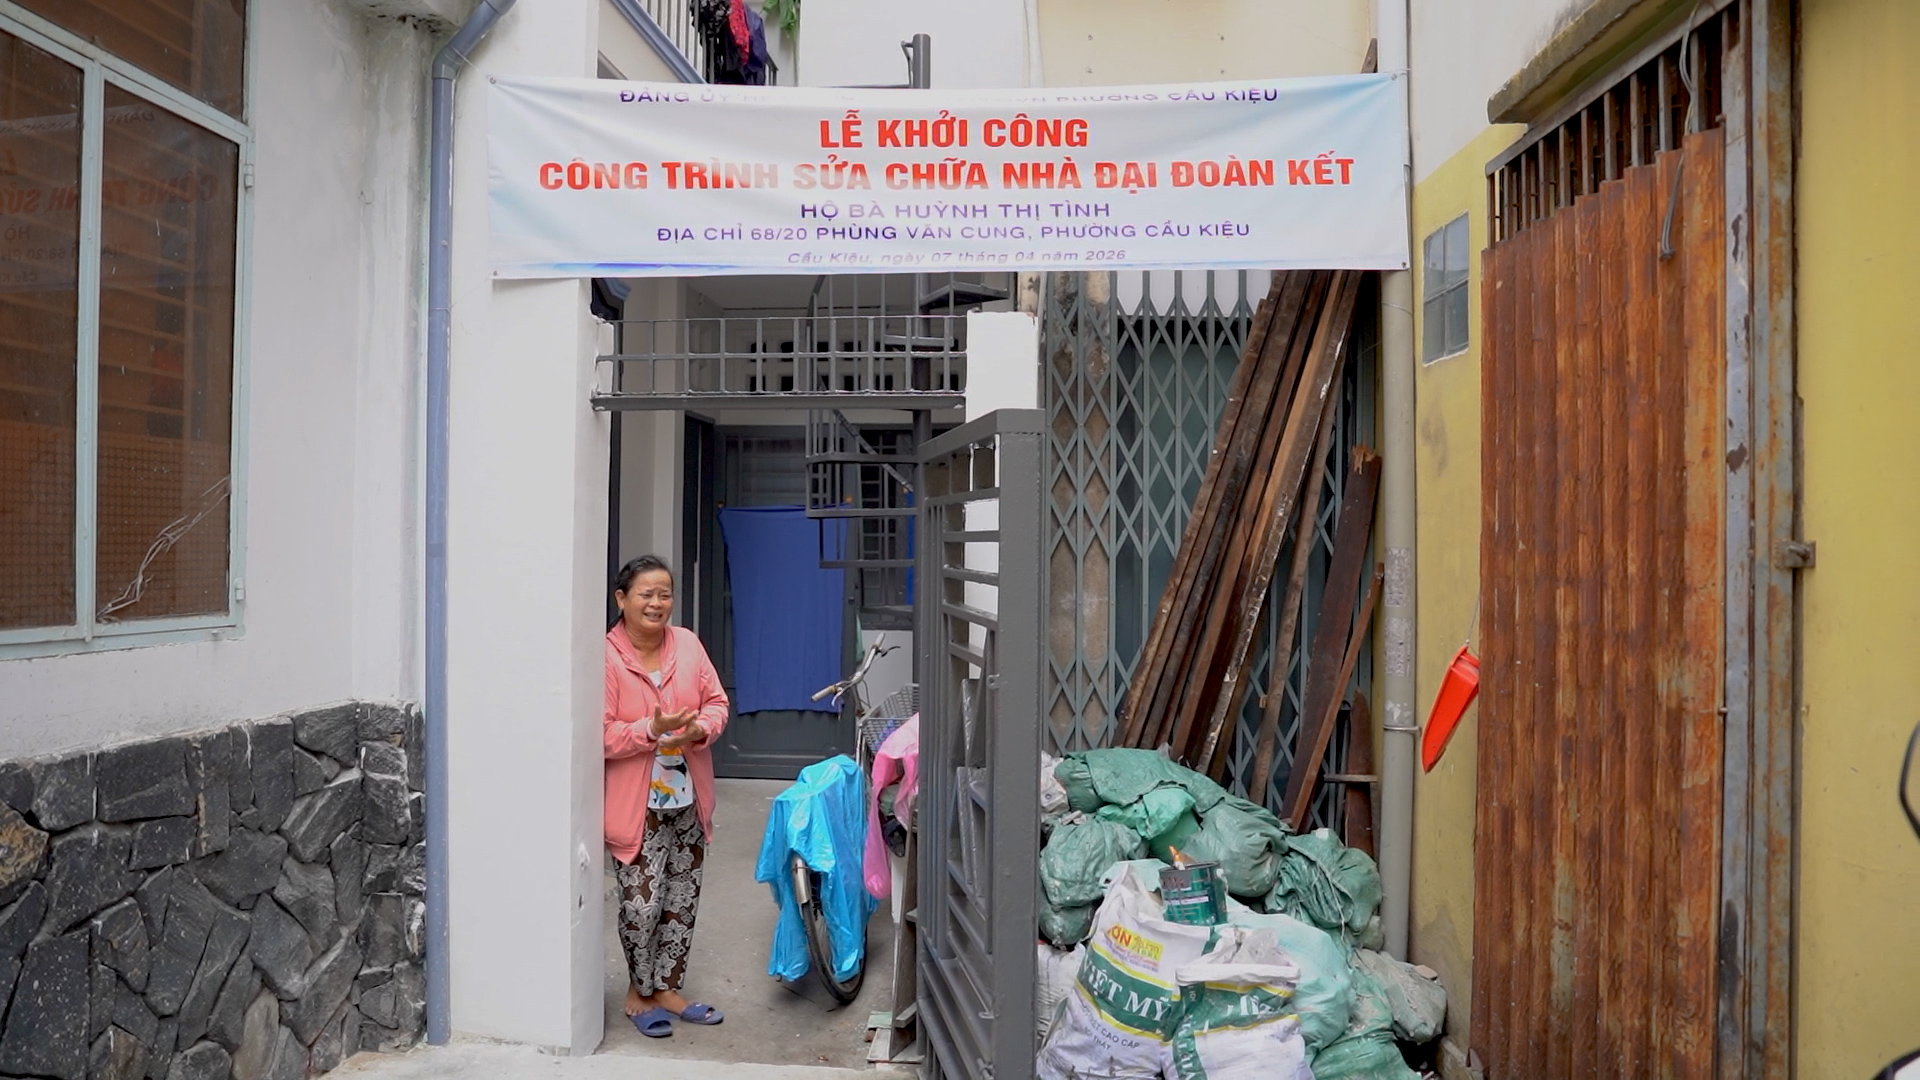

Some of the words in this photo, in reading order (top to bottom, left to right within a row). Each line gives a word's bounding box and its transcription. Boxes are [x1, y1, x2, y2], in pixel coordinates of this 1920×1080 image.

[619, 87, 689, 103] ĐẢNG
[1225, 87, 1278, 104] KIỆU
[819, 109, 863, 148] LỄ
[877, 109, 968, 148] KHỞI
[983, 113, 1088, 148] CÔNG
[539, 156, 648, 190] CÔNG
[661, 157, 778, 190] TRÌNH
[793, 154, 871, 190] SỬA
[885, 156, 988, 190] CHỮA
[1002, 156, 1082, 189] NHÀ
[1094, 161, 1158, 194] ĐẠI
[1170, 155, 1275, 188] ĐOÀN
[1286, 150, 1354, 186] KẾT
[800, 200, 839, 222] HỘ
[849, 201, 884, 219] BÀ
[895, 201, 988, 219] HUỲNH
[998, 203, 1040, 222] THỊ
[1050, 200, 1111, 218] TÌNH
[657, 227, 694, 244] ĐỊA
[703, 222, 743, 240] CHỈ
[751, 227, 807, 241] 68/20
[816, 223, 897, 240] PHÙNG
[906, 224, 952, 239] VĂN
[960, 225, 1032, 241] CUNG,
[1041, 222, 1136, 239] PHƯỜNG
[1145, 219, 1190, 238] CẦU
[1200, 220, 1250, 239] KIỆU
[881, 252, 925, 266] ngày
[932, 252, 952, 263] 07
[958, 250, 1009, 264] tháng
[1015, 250, 1036, 262] 04
[1042, 250, 1079, 261] năm
[1085, 250, 1126, 261] 2026
[1123, 988, 1172, 1021] MỸ
[1101, 1027, 1120, 1043] CAO
